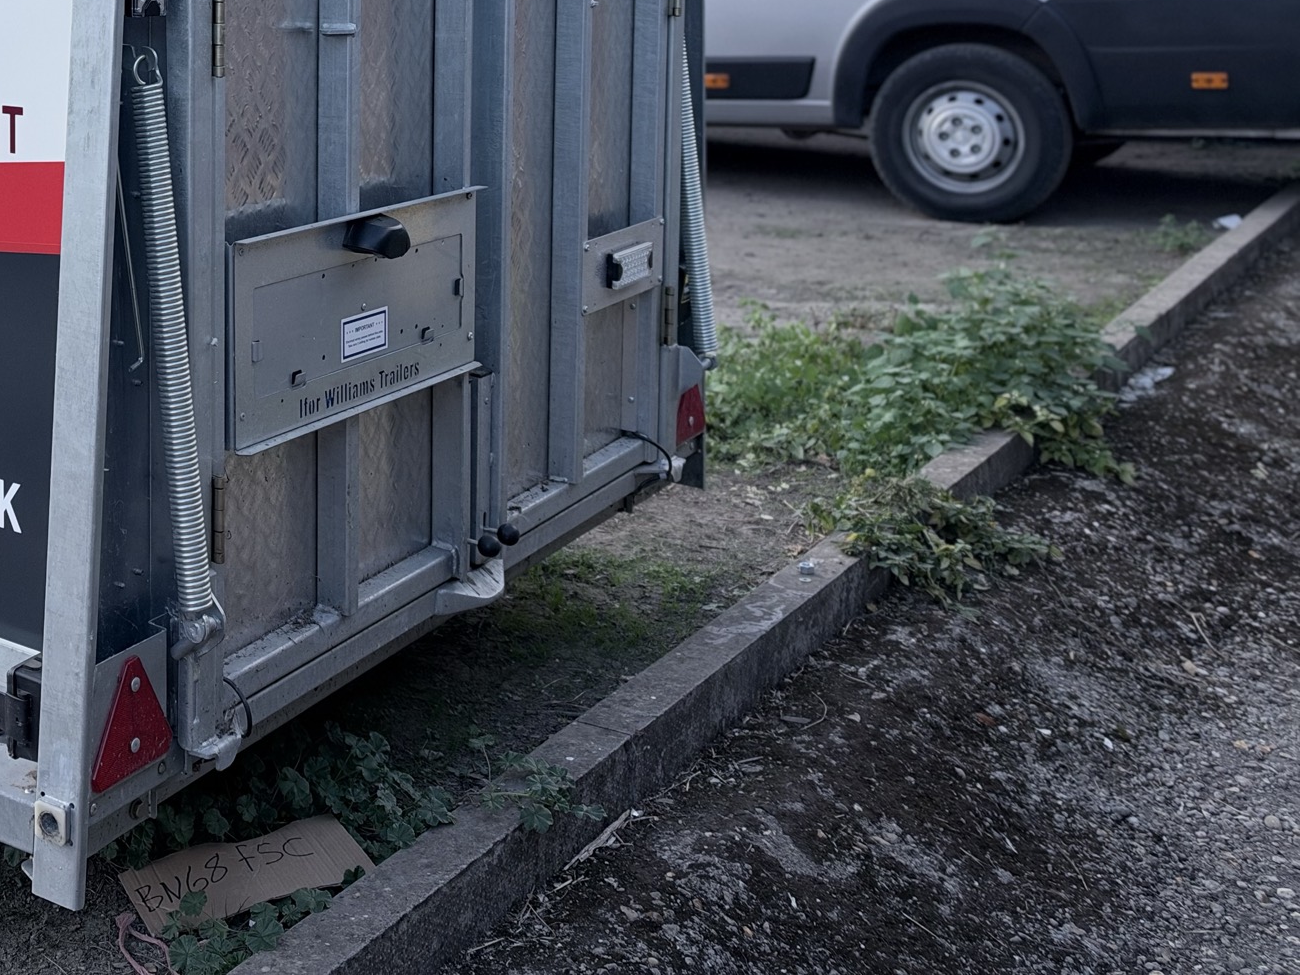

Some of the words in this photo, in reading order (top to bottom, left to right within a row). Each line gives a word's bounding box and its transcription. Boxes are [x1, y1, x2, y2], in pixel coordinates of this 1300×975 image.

[300, 396, 321, 418] Ifor
[325, 378, 376, 409] Williams
[380, 362, 419, 389] Trailers
[135, 852, 229, 913] BN68
